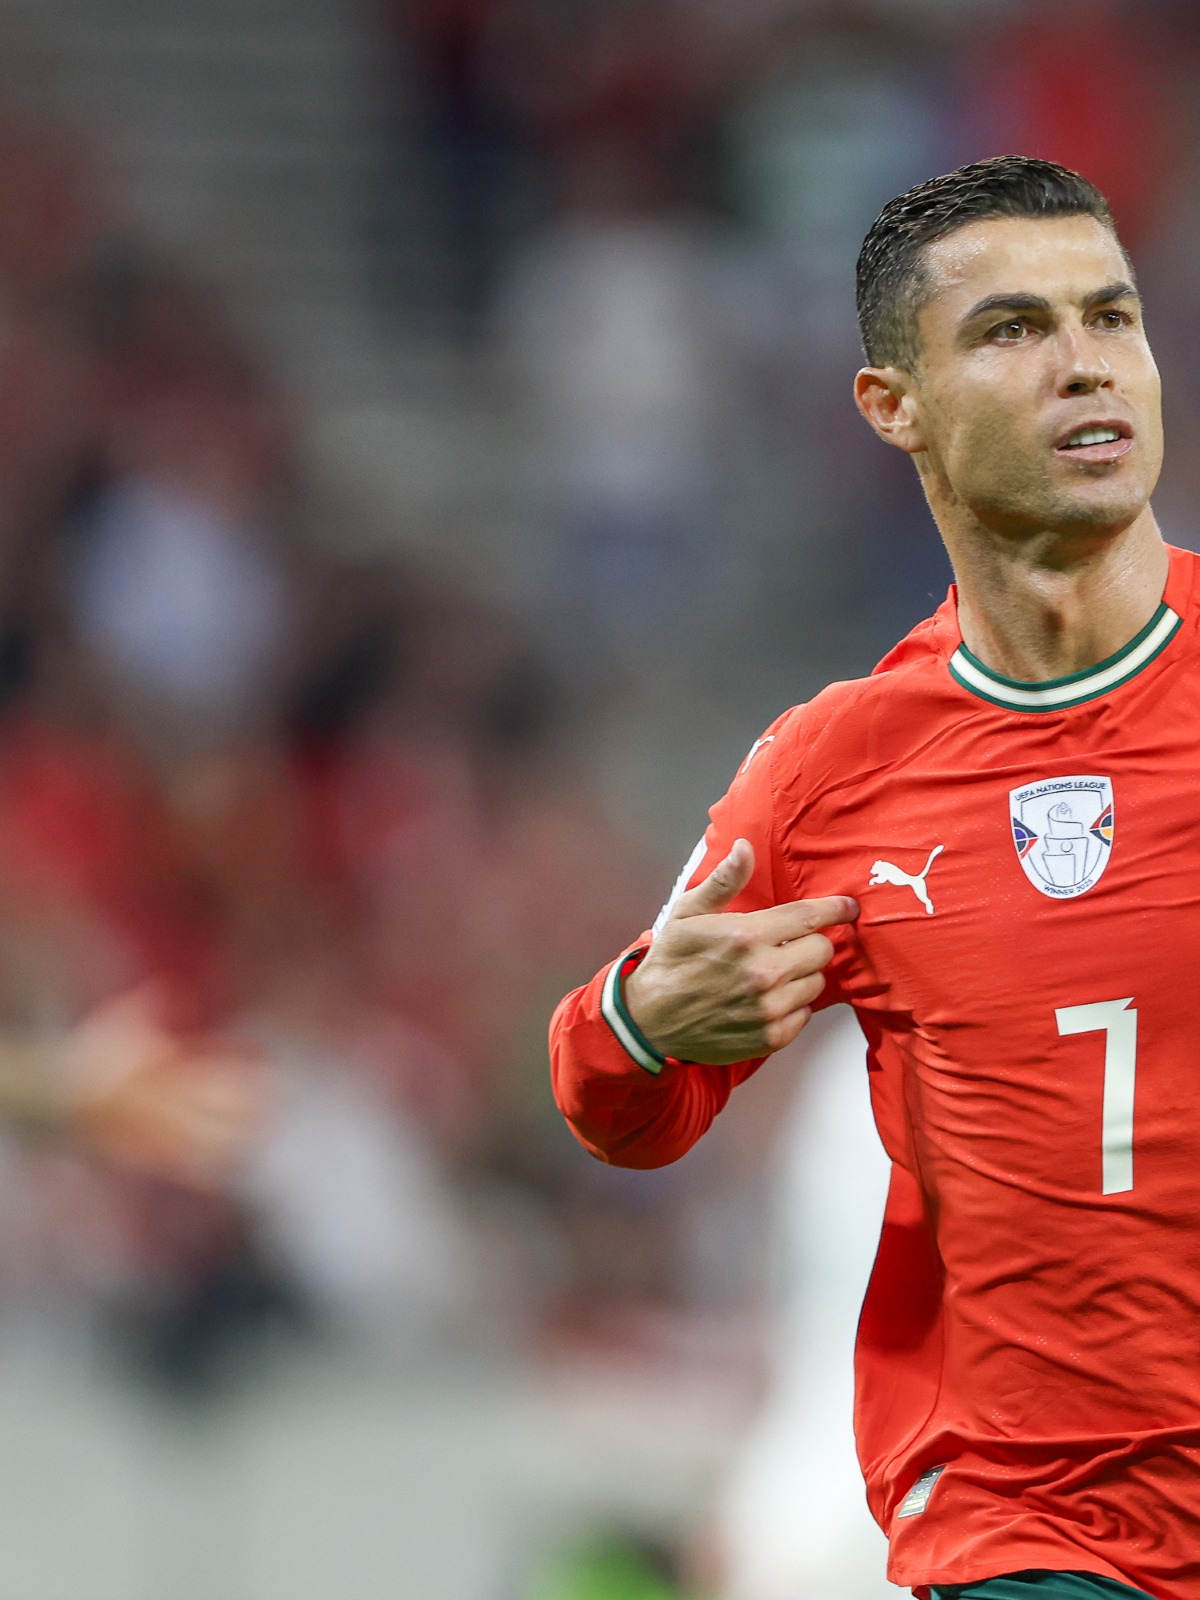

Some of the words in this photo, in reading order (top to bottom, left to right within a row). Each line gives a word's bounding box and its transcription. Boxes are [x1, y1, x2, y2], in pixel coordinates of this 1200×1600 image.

[1014, 790, 1035, 801] UEFA
[1036, 782, 1073, 794] NATIONS
[1074, 781, 1107, 790] LEAGUE
[1044, 884, 1075, 896] WINNER
[1054, 996, 1138, 1196] 7
